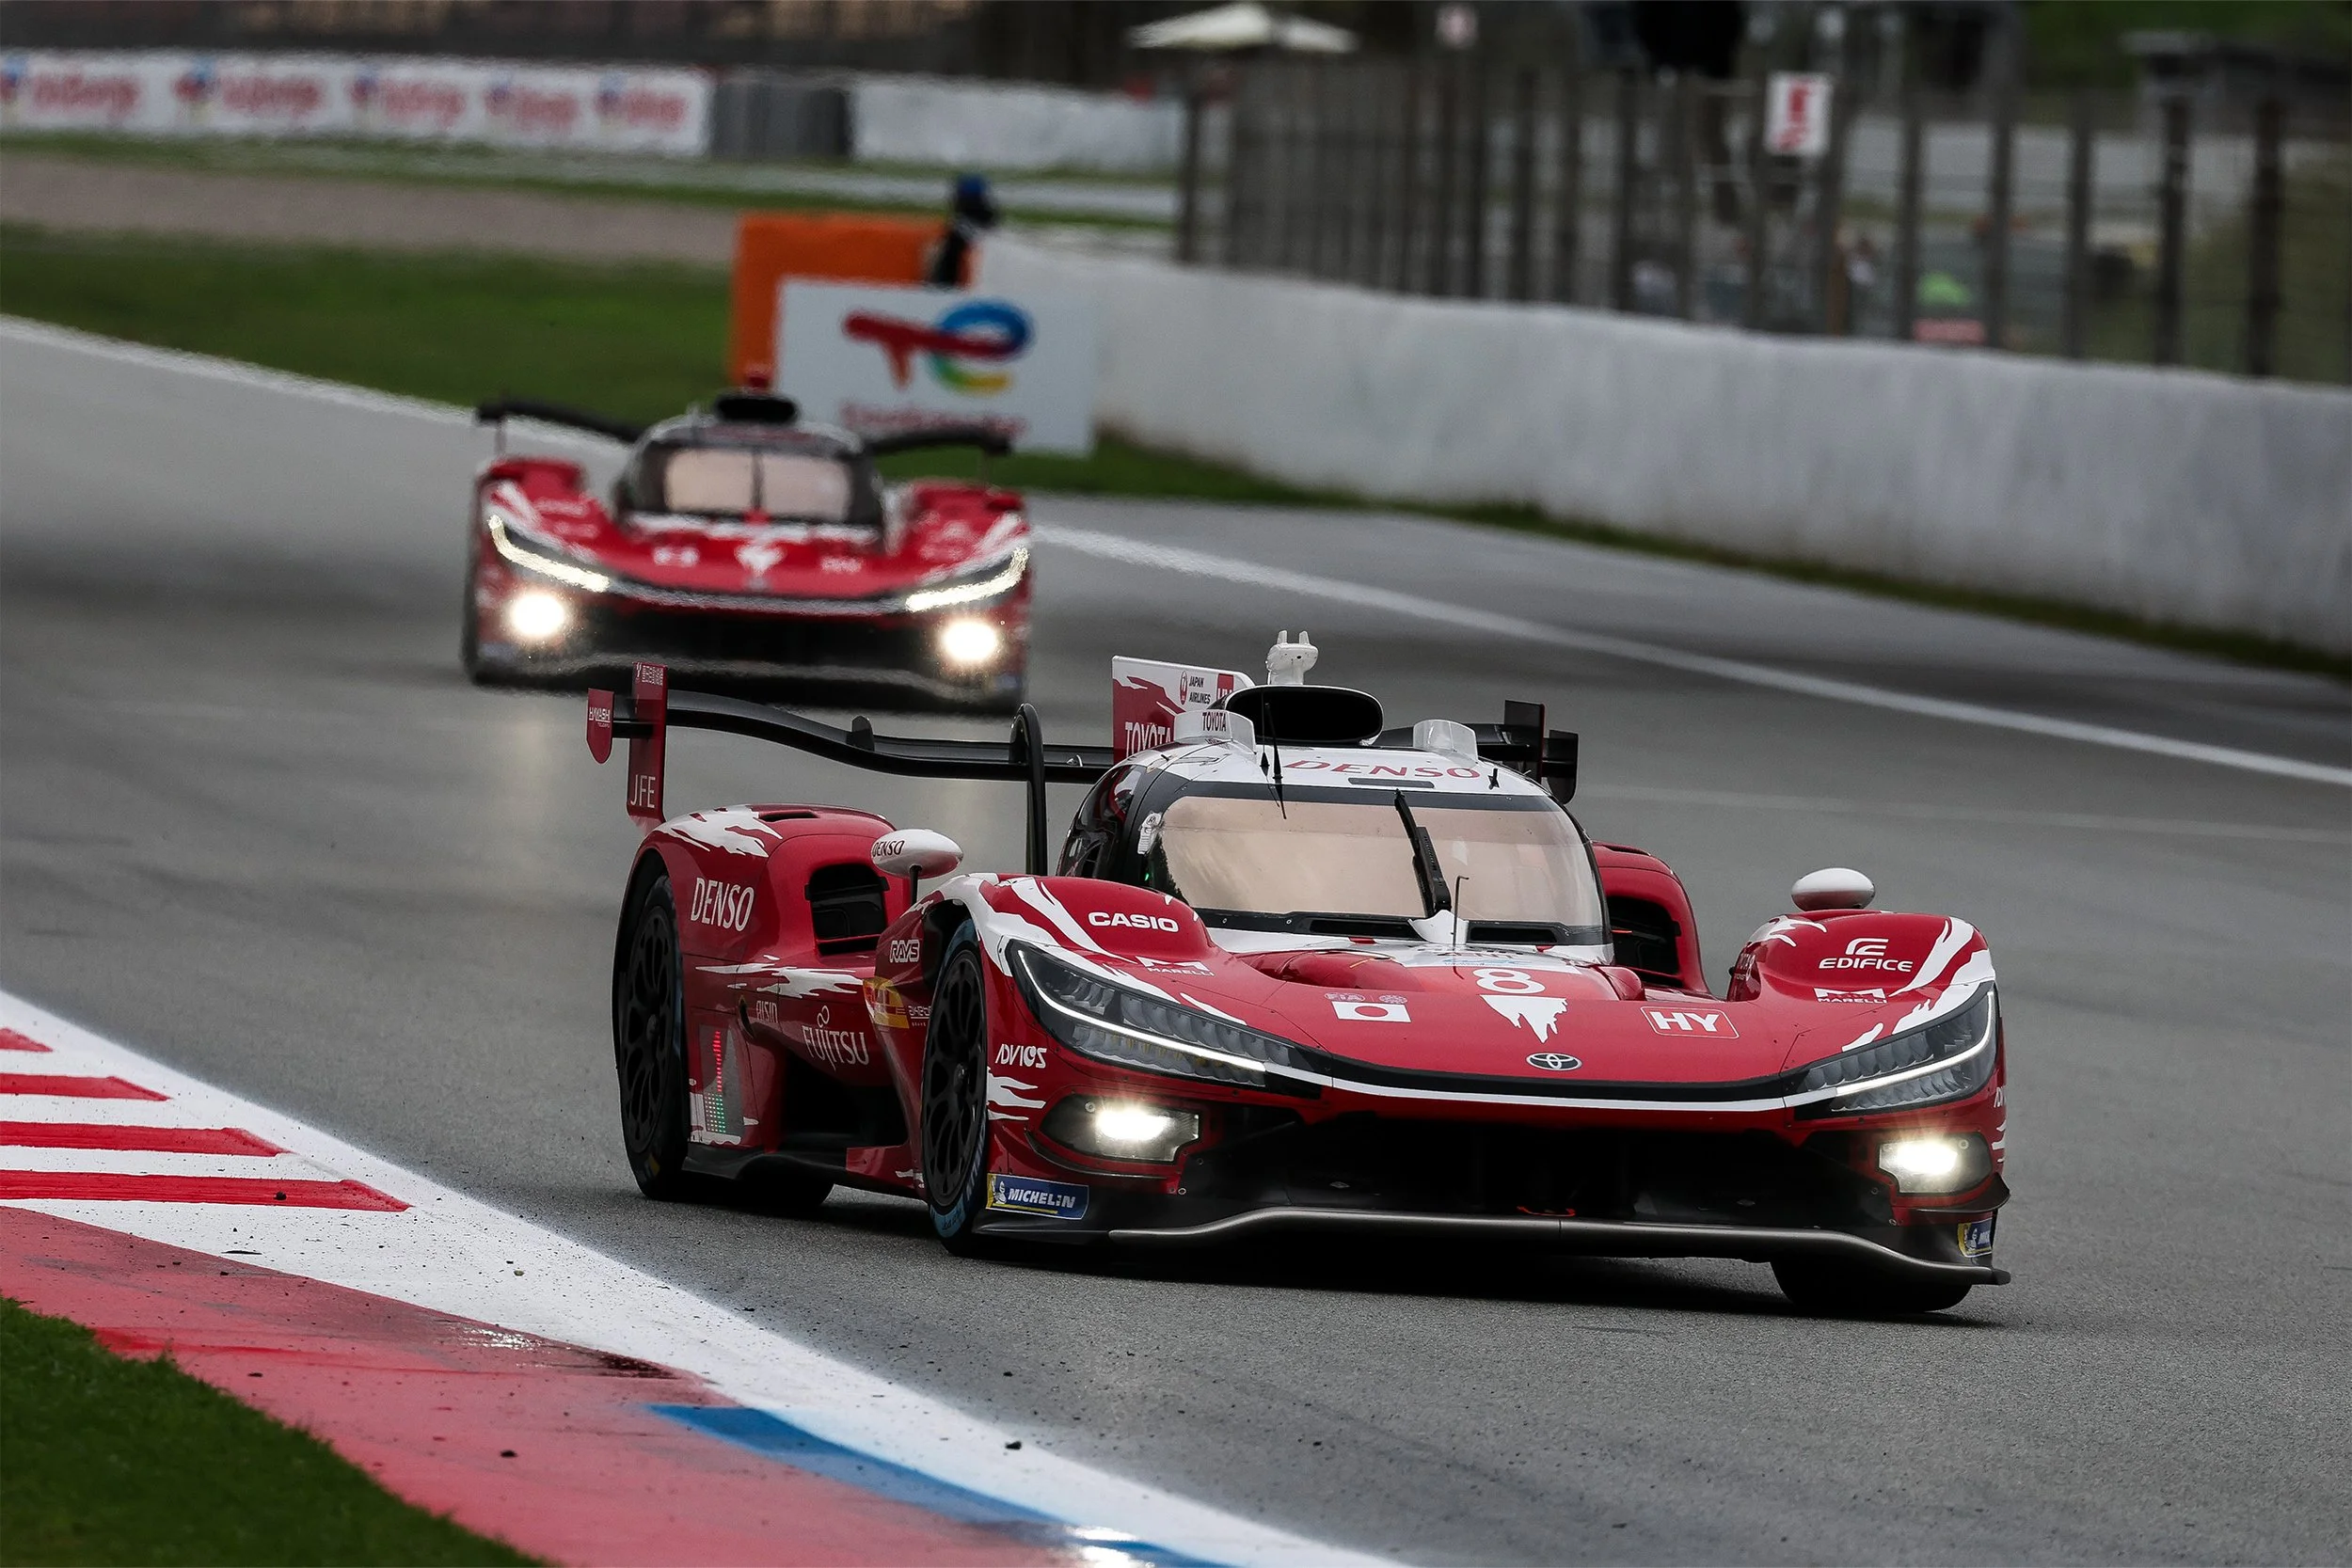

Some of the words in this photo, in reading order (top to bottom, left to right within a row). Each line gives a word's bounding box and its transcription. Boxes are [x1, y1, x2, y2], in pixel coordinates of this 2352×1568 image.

[1189, 675, 1204, 688] JAPAN
[1189, 691, 1211, 705] AIRLINES
[1202, 712, 1227, 732] TOYOTA
[1283, 759, 1481, 779] DENSO
[630, 774, 656, 809] JFE
[872, 840, 905, 857] DENSO
[690, 877, 755, 932] DENSO
[1088, 911, 1180, 933] CASIO
[889, 939, 920, 963] RAYS
[1148, 967, 1216, 976] MARELLI
[1818, 958, 1914, 973] EDIFICE
[1472, 968, 1546, 994] 8
[1649, 1010, 1721, 1033] HY
[802, 1024, 869, 1072] FUJITSU
[1008, 1188, 1076, 1209] MICHELIN
